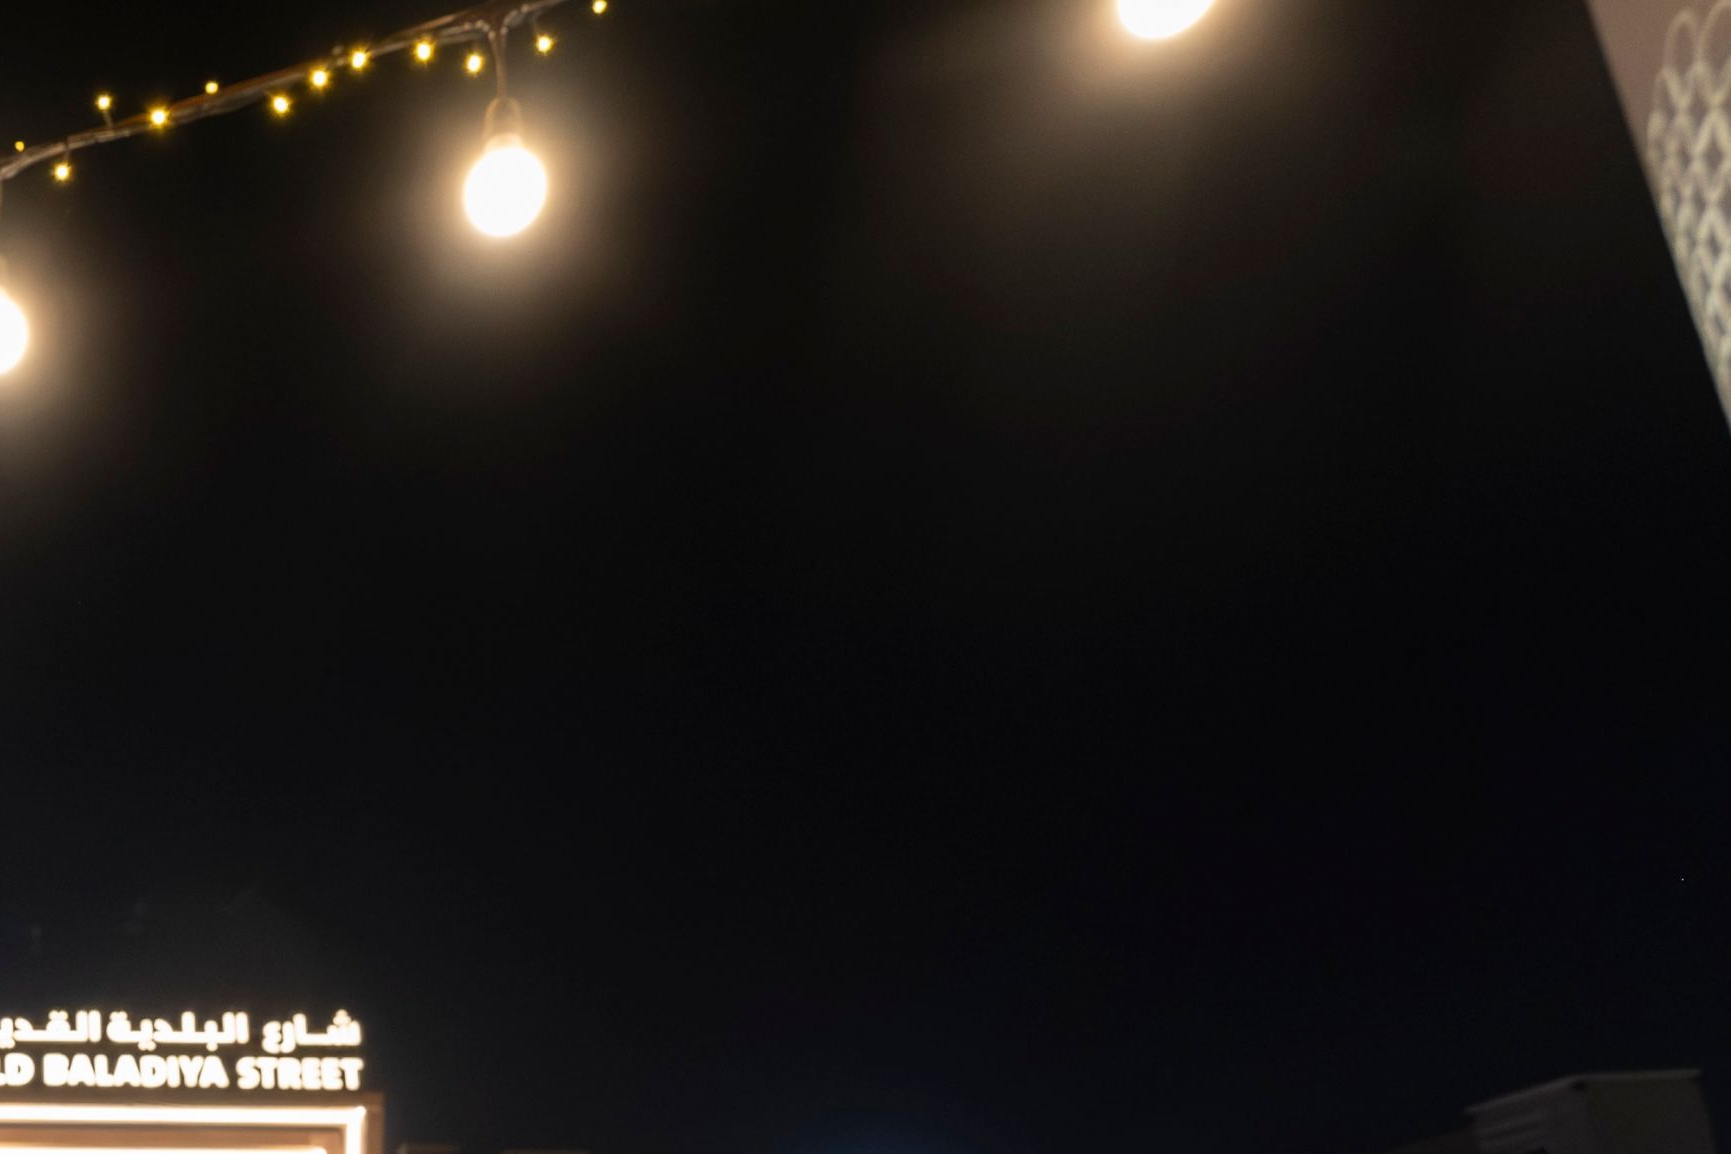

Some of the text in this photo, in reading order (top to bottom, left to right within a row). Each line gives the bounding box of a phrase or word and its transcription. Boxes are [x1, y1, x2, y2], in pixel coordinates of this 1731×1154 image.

[106, 1010, 251, 1052] البلدية
[263, 1009, 362, 1054] شارع
[42, 1053, 230, 1088] BALADIYA
[235, 1056, 364, 1091] STREET
